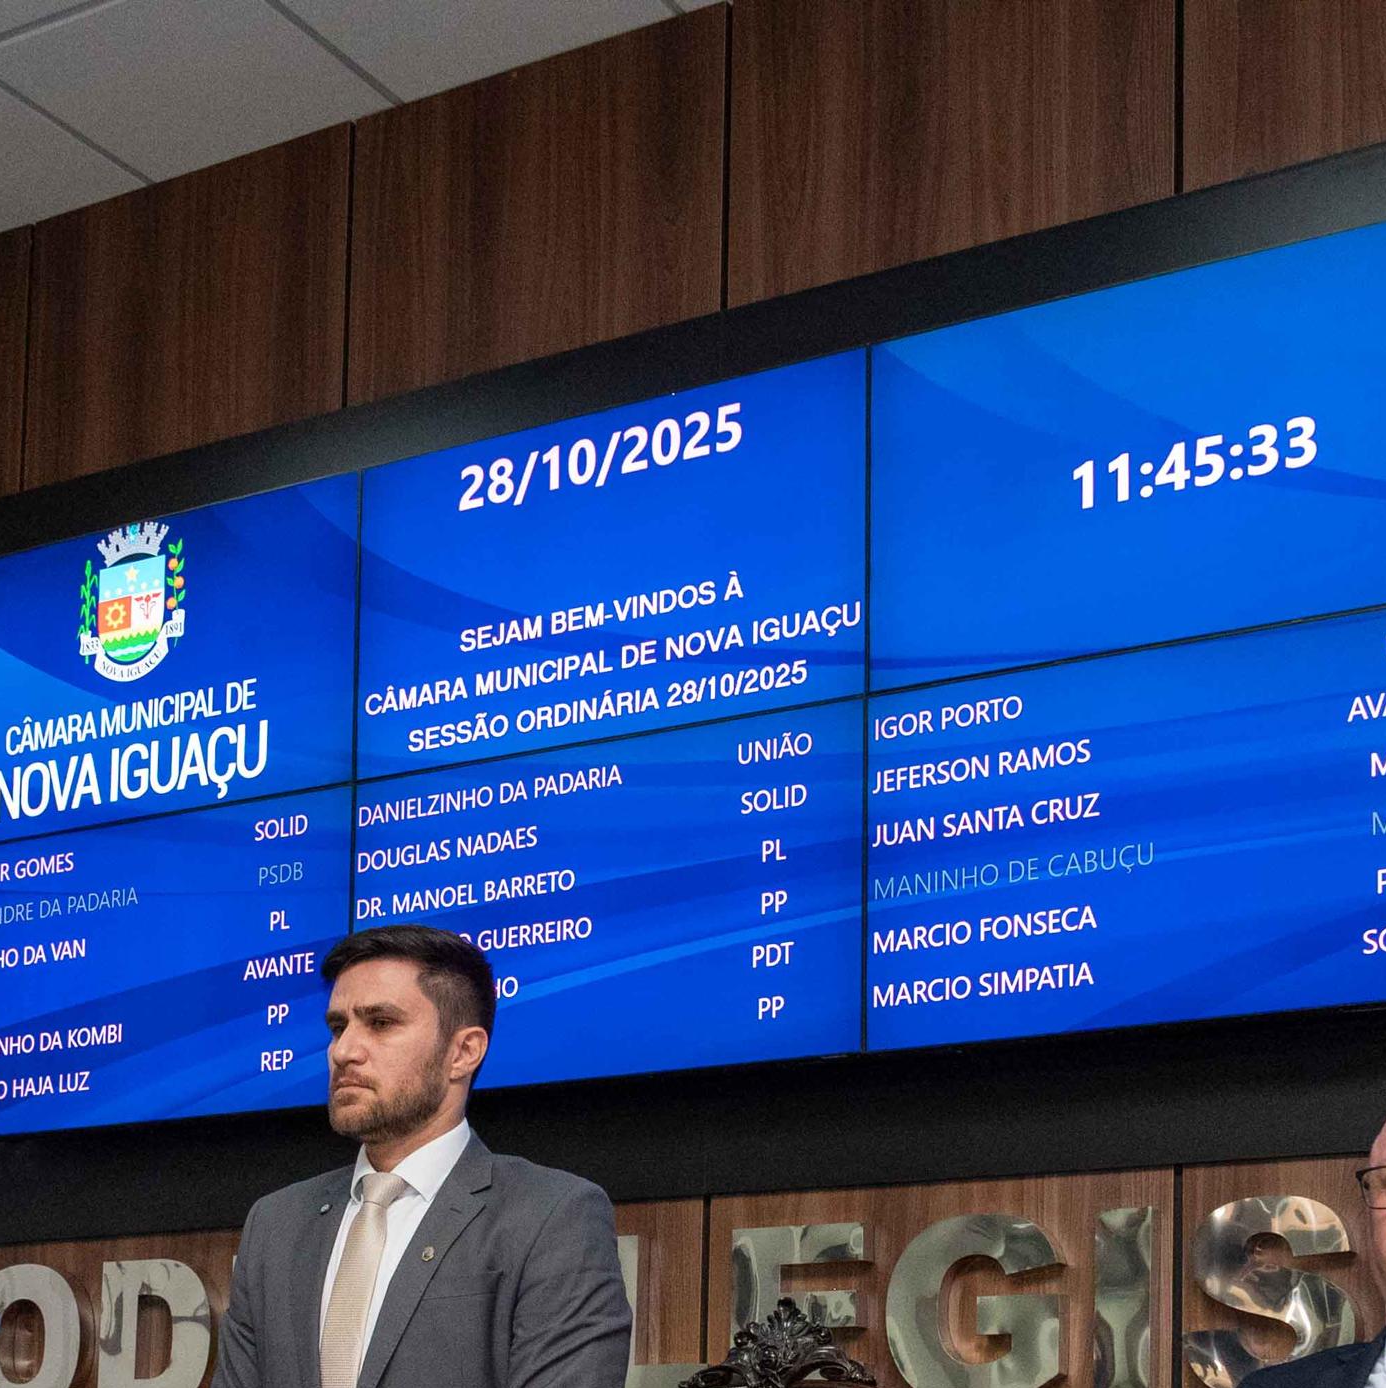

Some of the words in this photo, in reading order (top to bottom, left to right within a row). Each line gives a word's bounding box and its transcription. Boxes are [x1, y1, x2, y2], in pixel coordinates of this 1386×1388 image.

[458, 402, 743, 512] 28/10/2025
[1072, 415, 1318, 510] 11:45:33
[459, 614, 543, 653] SEJAM
[550, 580, 717, 635] BEM-VINDOS
[723, 570, 744, 601] À
[364, 676, 469, 716] CÂMARA
[475, 649, 614, 697] MUNICIPAL
[621, 639, 657, 669] DE
[665, 624, 745, 661] NOVA
[752, 600, 861, 650] IGUAÇU
[5, 711, 98, 756] CÂMARA
[100, 686, 222, 738] MUNICIPAL
[225, 677, 257, 714] DE
[407, 712, 509, 753] SESSÃO
[515, 687, 660, 733] ORDINÁRIA
[666, 659, 808, 708] 28/10/2025
[874, 710, 934, 741] IGOR
[941, 695, 1023, 731] PORTO
[109, 719, 269, 803] IGUAÇU
[737, 731, 813, 765] UNIÃO
[872, 754, 990, 795] JEFERSON
[998, 738, 1091, 776] RAMOS
[358, 785, 494, 827] DANIELZINHO
[499, 780, 528, 805] DA
[534, 764, 623, 799] PADARIA
[740, 783, 808, 815] SOLID
[254, 814, 309, 842] SOLID
[871, 816, 935, 848] JUAN
[942, 804, 1025, 838] SANTA
[1031, 792, 1101, 825] CRUZ
[14, 852, 75, 879] GOMES
[357, 839, 451, 873] DOUGLAS
[456, 825, 538, 858] NADAES
[761, 838, 787, 863] PL
[258, 861, 304, 887] PSDB
[874, 863, 999, 900] MANINHO
[1008, 857, 1039, 883] DE
[1048, 841, 1154, 878] CABUÇU
[39, 898, 62, 919] DA
[67, 886, 139, 915] PADARIA
[356, 896, 387, 920] DR.
[392, 883, 479, 915] MANOEL
[484, 869, 576, 902] BARRETO
[761, 889, 788, 915] PP
[269, 910, 290, 932] PL
[477, 916, 593, 952] GUERREIRO
[873, 920, 972, 955] MARCIO
[979, 905, 1098, 942] FONSECA
[23, 944, 47, 966] DA
[50, 938, 86, 962] VAN
[243, 951, 315, 981] AVANTE
[752, 941, 795, 969] PDT
[873, 975, 972, 1008] MARCIO
[978, 961, 1095, 997] SIMPATIA
[267, 1003, 290, 1026] PP
[758, 995, 785, 1020] PP
[39, 1030, 63, 1052] DA
[67, 1023, 123, 1049] KOMBI
[260, 1049, 294, 1072] REP
[12, 1075, 54, 1099] HAJA
[58, 1070, 91, 1094] LUZ
